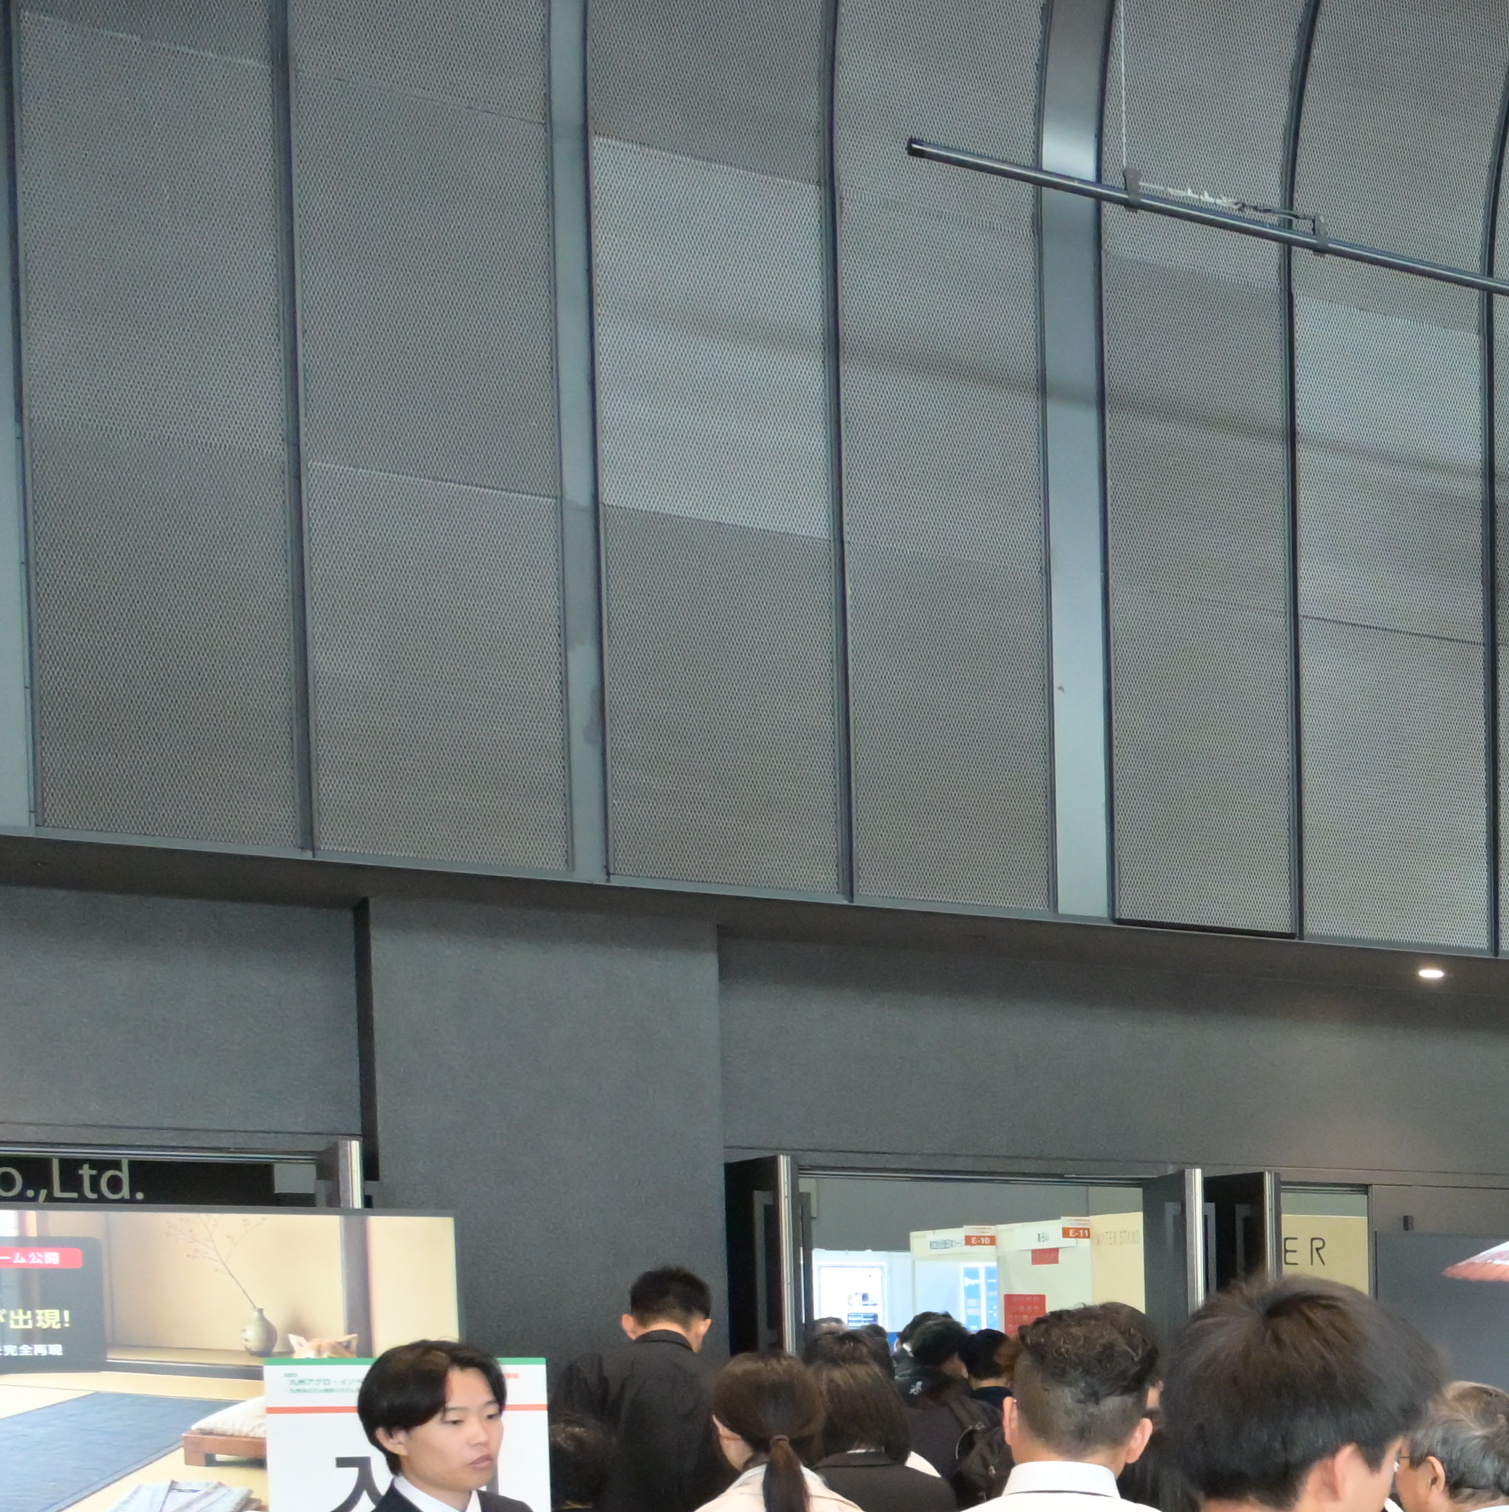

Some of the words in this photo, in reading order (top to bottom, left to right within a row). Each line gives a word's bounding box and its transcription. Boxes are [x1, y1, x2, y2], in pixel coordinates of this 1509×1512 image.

[1069, 1229, 1089, 1238] E-11
[971, 1237, 990, 1245] E-10
[0, 1308, 70, 1329] 出現!
[0, 1344, 63, 1356] 完全再現
